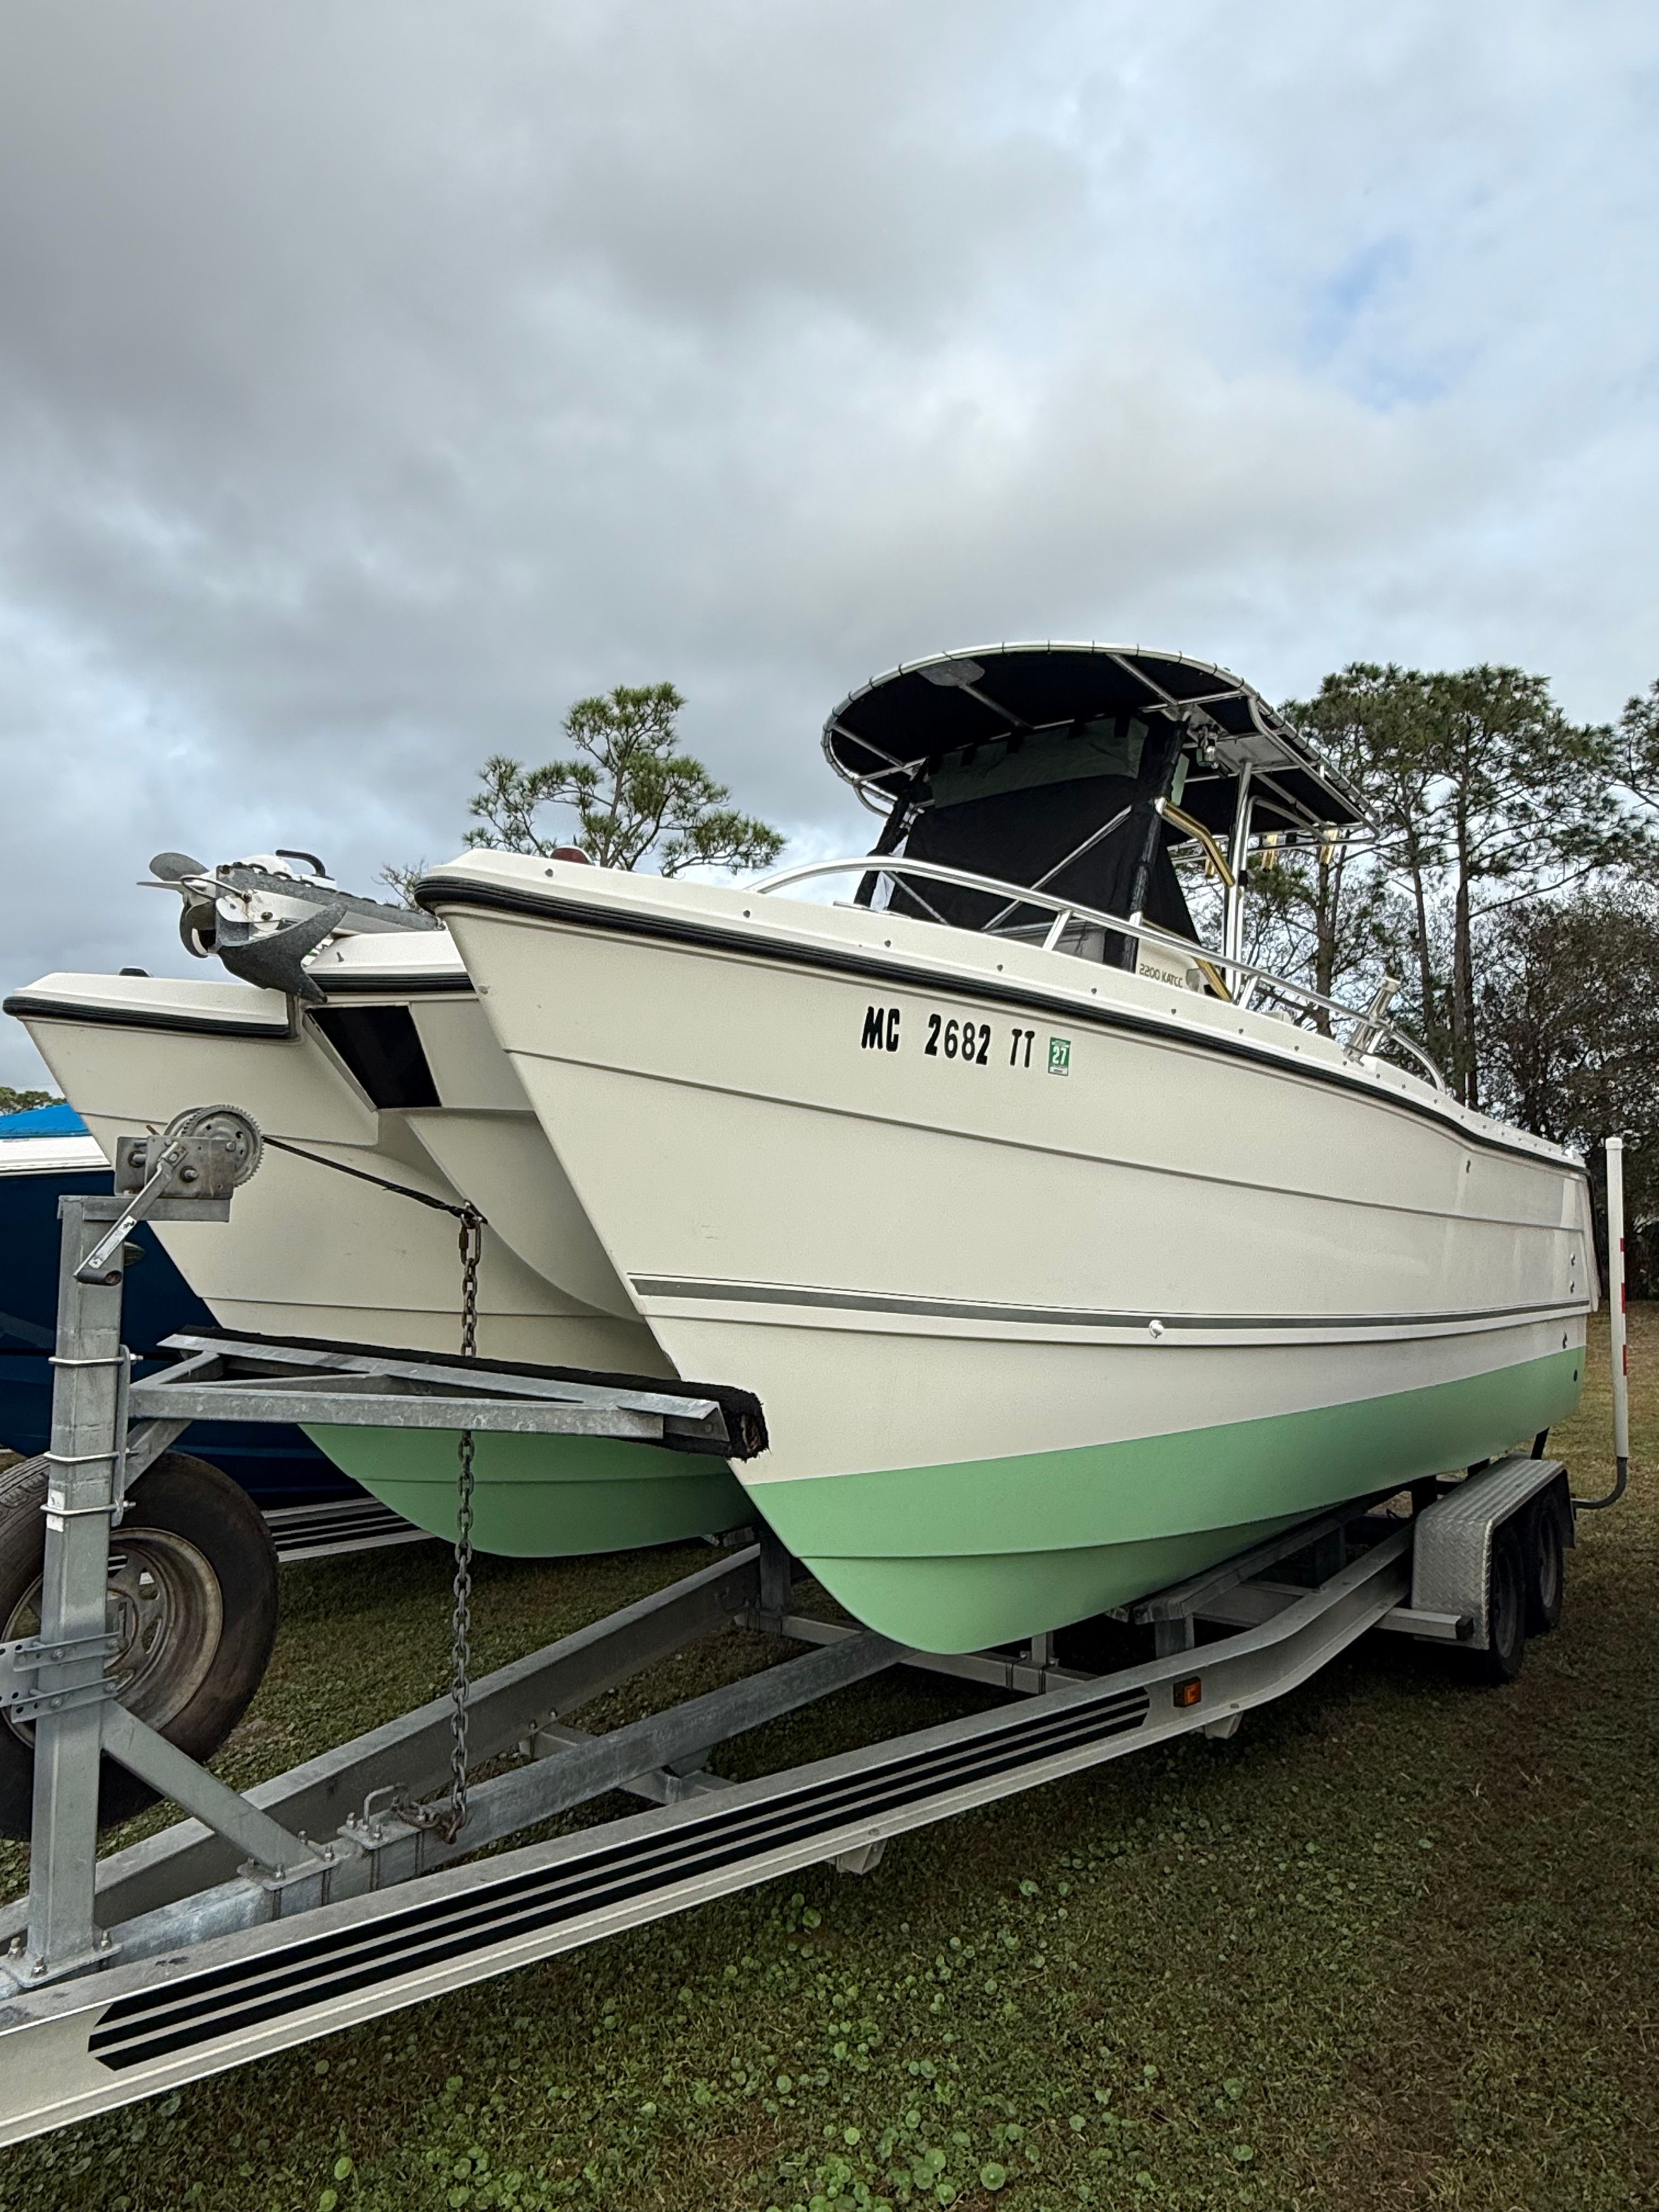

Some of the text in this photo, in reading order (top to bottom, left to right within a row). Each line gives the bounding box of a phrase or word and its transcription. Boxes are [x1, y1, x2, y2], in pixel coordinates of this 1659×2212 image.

[1139, 963, 1160, 980] 2200
[862, 1006, 1035, 1068] MC 2682 TT
[1052, 1046, 1066, 1065] 27
